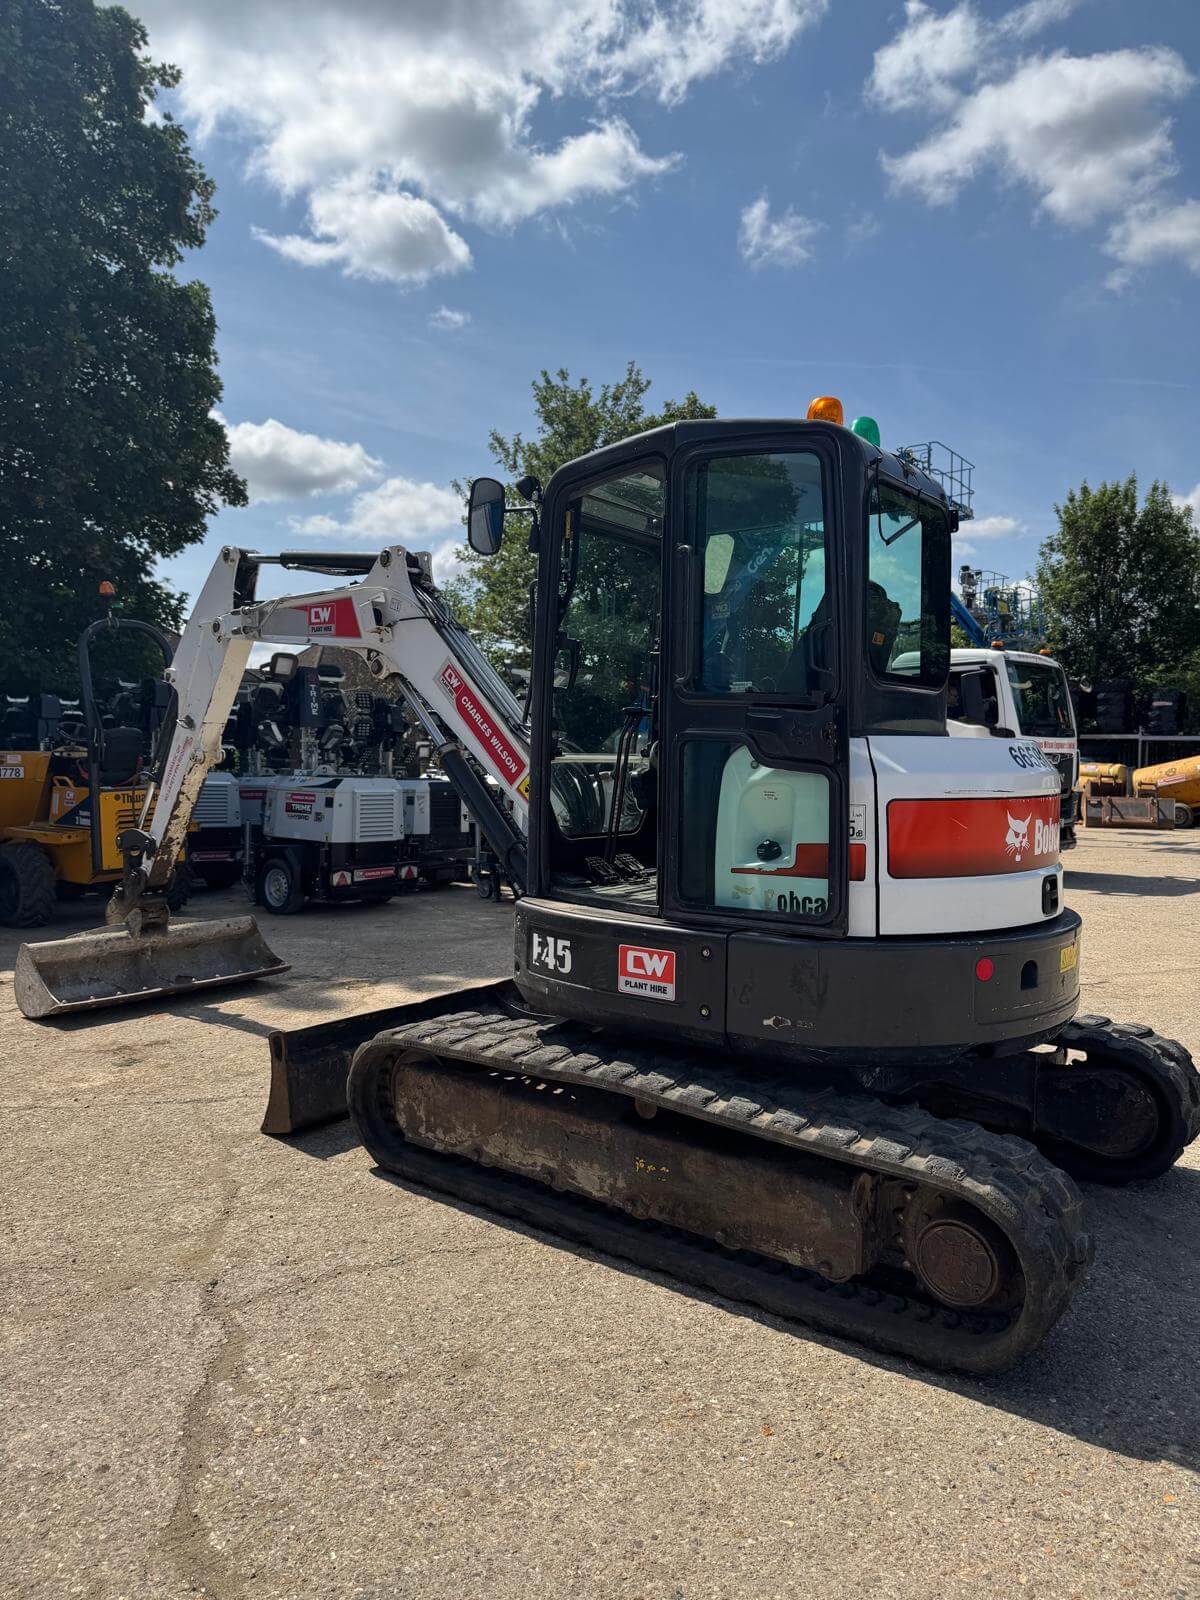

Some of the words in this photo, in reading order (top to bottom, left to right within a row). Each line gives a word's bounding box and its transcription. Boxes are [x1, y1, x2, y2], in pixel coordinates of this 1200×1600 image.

[310, 606, 332, 622] CW
[461, 695, 492, 738] CHARLES
[489, 734, 519, 773] WILSON
[777, 890, 829, 915] obca
[626, 950, 669, 978] CW
[624, 979, 649, 992] PLANT
[649, 984, 668, 995] HIRE
